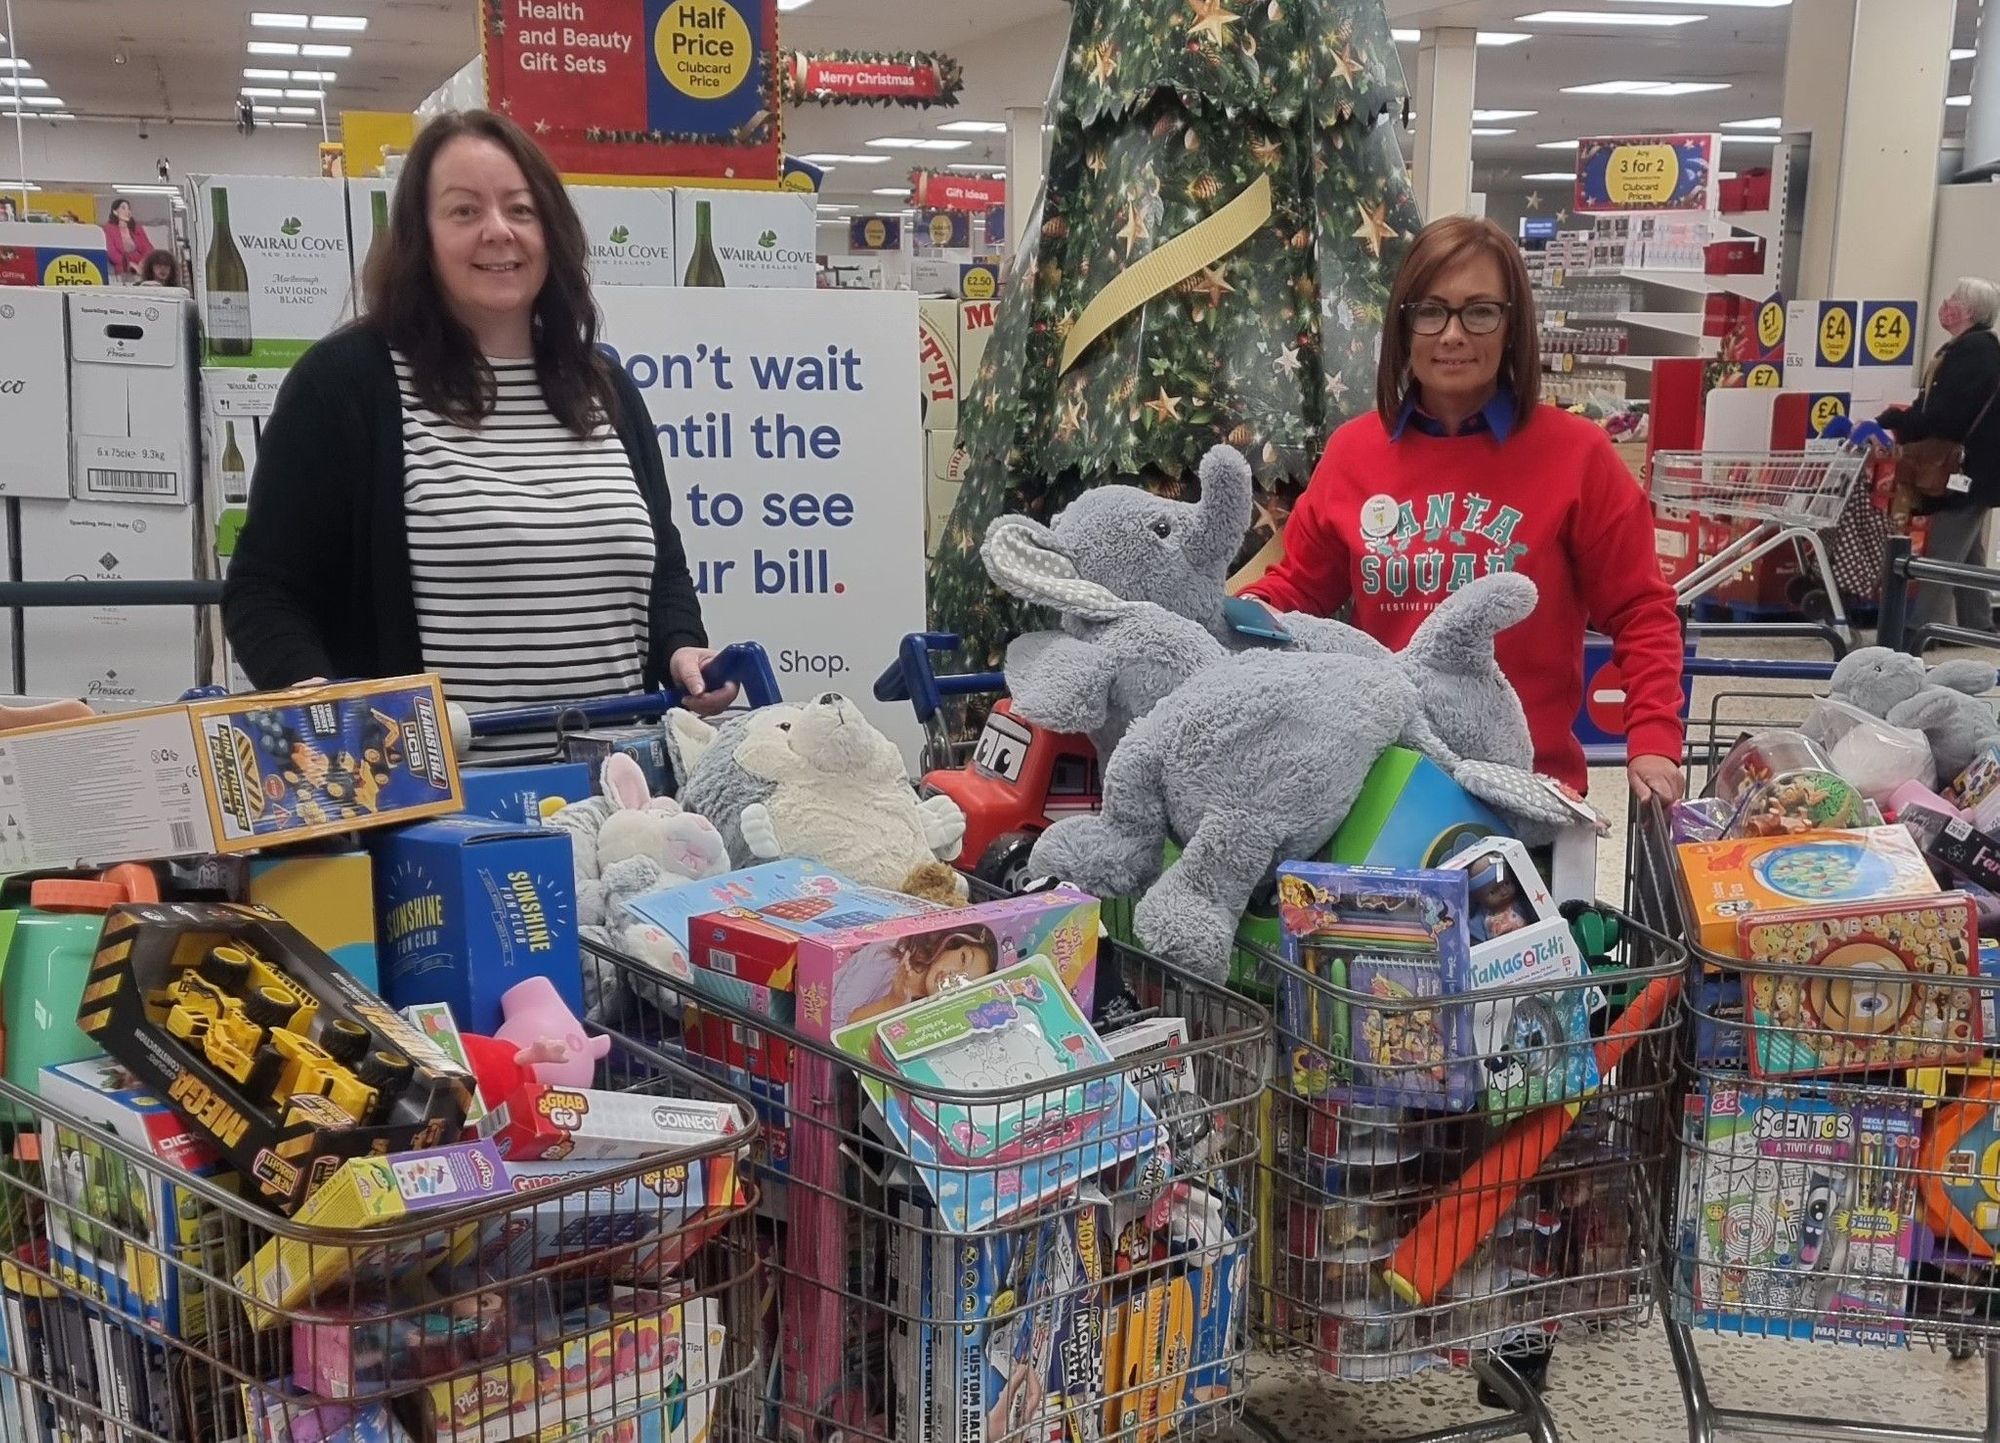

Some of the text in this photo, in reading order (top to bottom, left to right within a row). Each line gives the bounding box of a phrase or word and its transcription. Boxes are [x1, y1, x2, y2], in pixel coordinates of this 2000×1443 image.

[518, 0, 584, 20] Health
[679, 6, 726, 29] Half
[519, 28, 632, 53] and Beauty
[672, 32, 733, 56] Price
[520, 52, 607, 73] Gift Sets
[677, 61, 731, 74] Clubcard
[690, 75, 720, 87] Price
[819, 71, 915, 86] Merry Christmas
[1620, 159, 1665, 173] 3 for 2
[946, 187, 989, 200] Gift Ideas
[1623, 183, 1659, 191] Clubcard
[1628, 192, 1652, 200] Prices
[239, 235, 346, 251] WAIRAU COVE
[587, 244, 669, 258] AIRAU COVE
[719, 247, 814, 264] WAIRAU COVE
[59, 261, 87, 274] Half
[55, 276, 92, 286] Price
[264, 286, 328, 295] SAUVIGNON
[967, 277, 992, 286] £2.50
[280, 296, 314, 304] BLANC
[965, 303, 1000, 330] M
[1763, 306, 1776, 331] £7
[1826, 316, 1847, 340] £4
[1874, 315, 1902, 339] £4
[750, 345, 864, 391] wait
[1754, 370, 1773, 386] £7
[1818, 402, 1838, 419] £4
[656, 411, 842, 459] ntil the
[142, 449, 165, 460] 9.3kg
[687, 484, 854, 527] to see
[1361, 491, 1523, 548] ANTA
[754, 549, 846, 594] bill.
[1380, 602, 1420, 611] FESTIVE
[779, 650, 851, 677] Shop.
[88, 680, 136, 696] Prosecco
[405, 727, 420, 766] JCB
[418, 703, 446, 780] TEAMSTERZ
[212, 739, 234, 813] PLAYSET
[220, 728, 248, 828] MINI TRUCKS
[386, 894, 444, 943] SUNSHINE
[508, 871, 550, 952] SUNSHINE
[510, 913, 526, 944] CLUB
[415, 930, 438, 949] CLUB
[168, 1068, 250, 1148] MEGA
[539, 1100, 550, 1113] &
[547, 1091, 586, 1110] GRAB
[550, 1107, 580, 1127] GO
[655, 1111, 720, 1131] CONNECT
[1754, 1107, 1852, 1140] SCENTOS
[1815, 1144, 1833, 1155] FUN
[265, 1155, 297, 1180] BRIGHT
[271, 1174, 290, 1192] NEW
[1815, 1326, 1852, 1338] MAZE
[970, 1345, 980, 1406] CUSTOM
